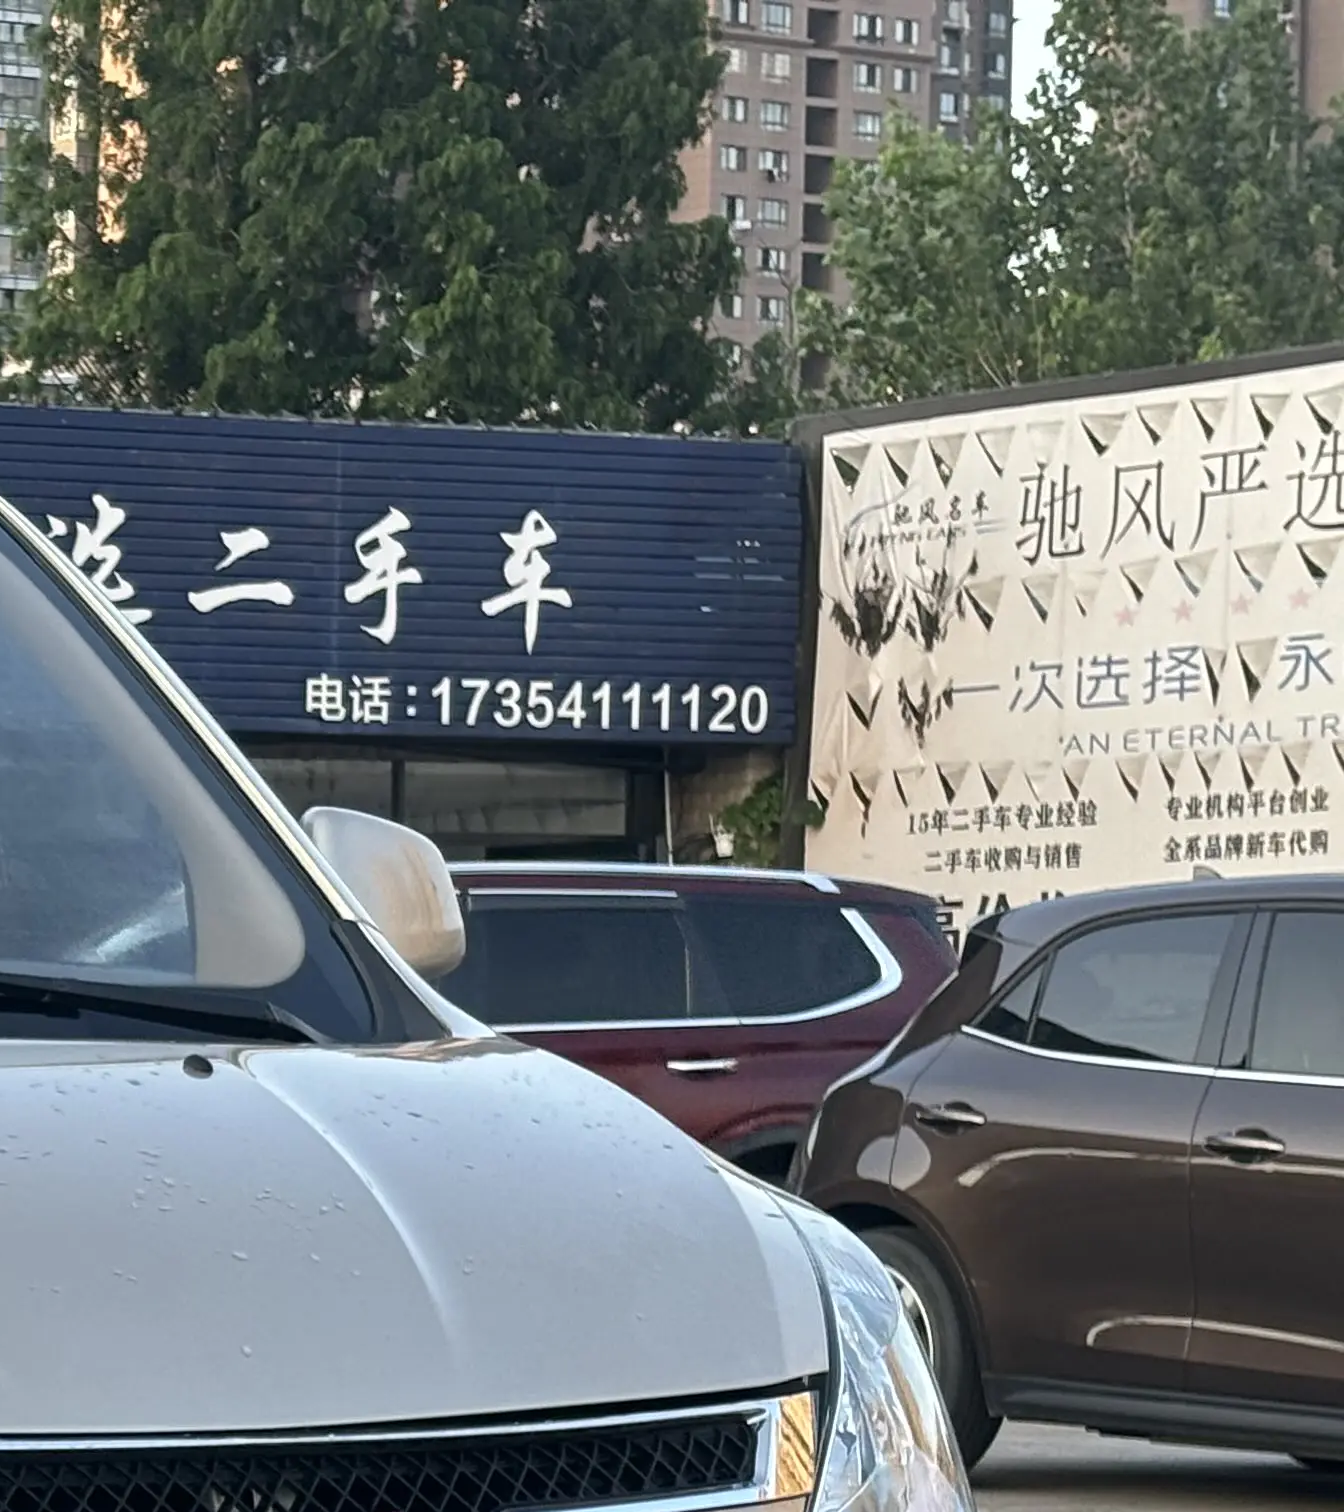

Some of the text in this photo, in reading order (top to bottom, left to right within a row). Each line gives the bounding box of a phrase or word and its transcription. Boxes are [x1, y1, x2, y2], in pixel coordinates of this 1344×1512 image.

[950, 645, 1202, 712] 一次选择
[1064, 733, 1111, 757] AN
[1122, 719, 1282, 753] ETERNAL
[906, 786, 1330, 836] 15年二手车专业经验 专业机构平台创业
[923, 829, 1330, 875] 二手车收购与销售 全系品牌新车代购
